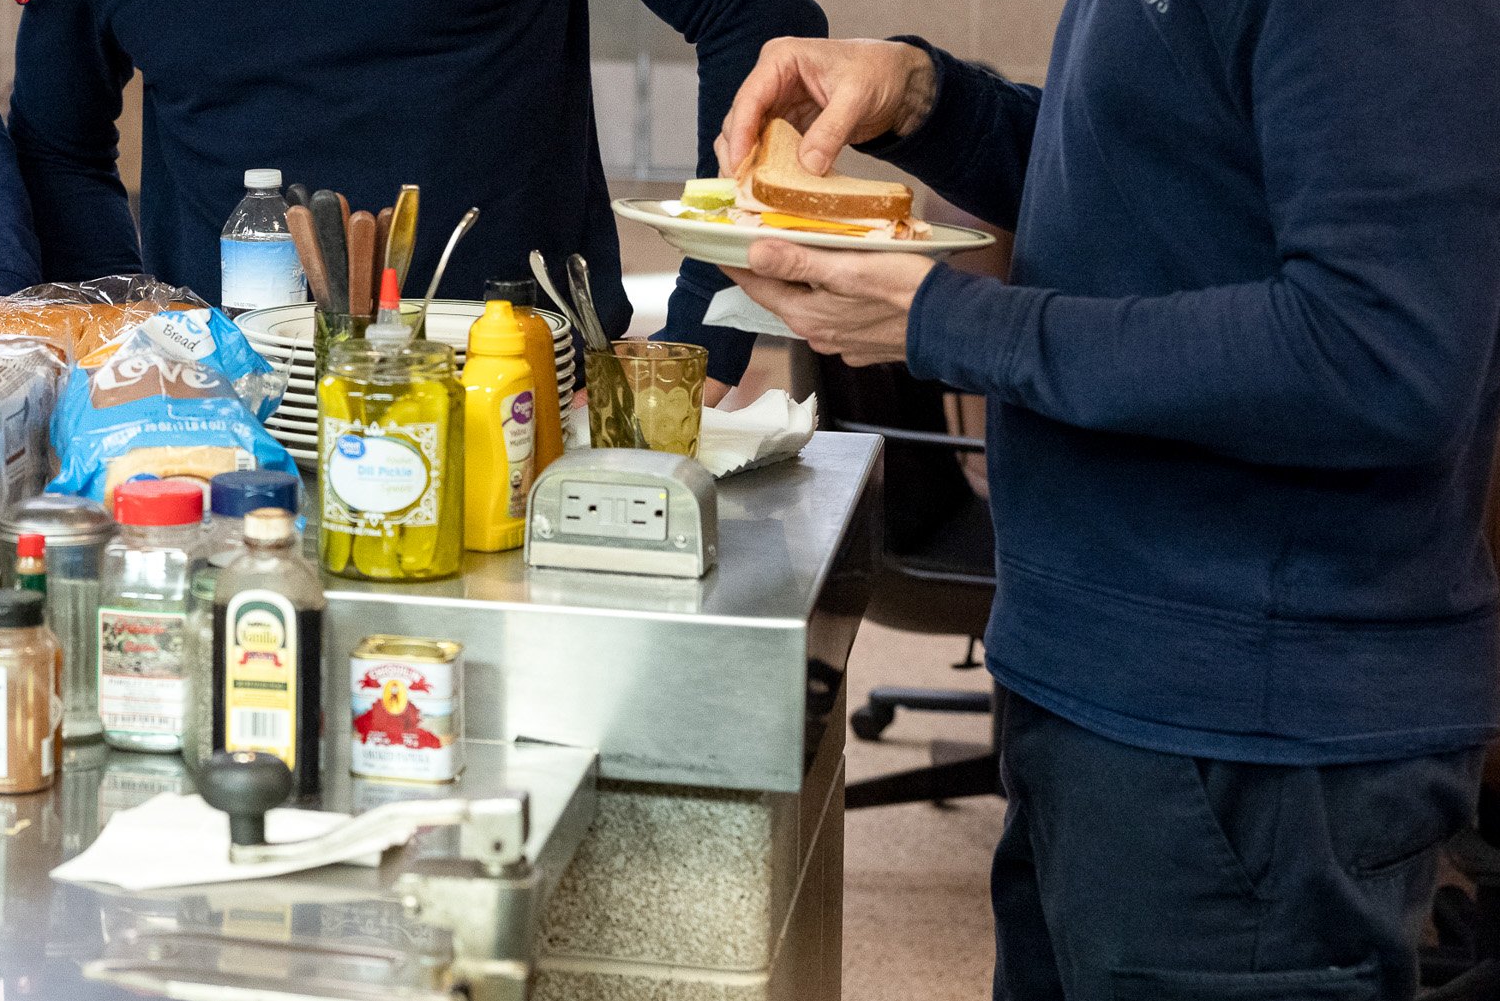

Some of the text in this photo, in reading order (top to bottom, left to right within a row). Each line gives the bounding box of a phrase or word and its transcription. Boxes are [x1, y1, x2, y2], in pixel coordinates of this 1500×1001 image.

[162, 323, 201, 352] Bread
[358, 465, 412, 477] Dill Pickle
